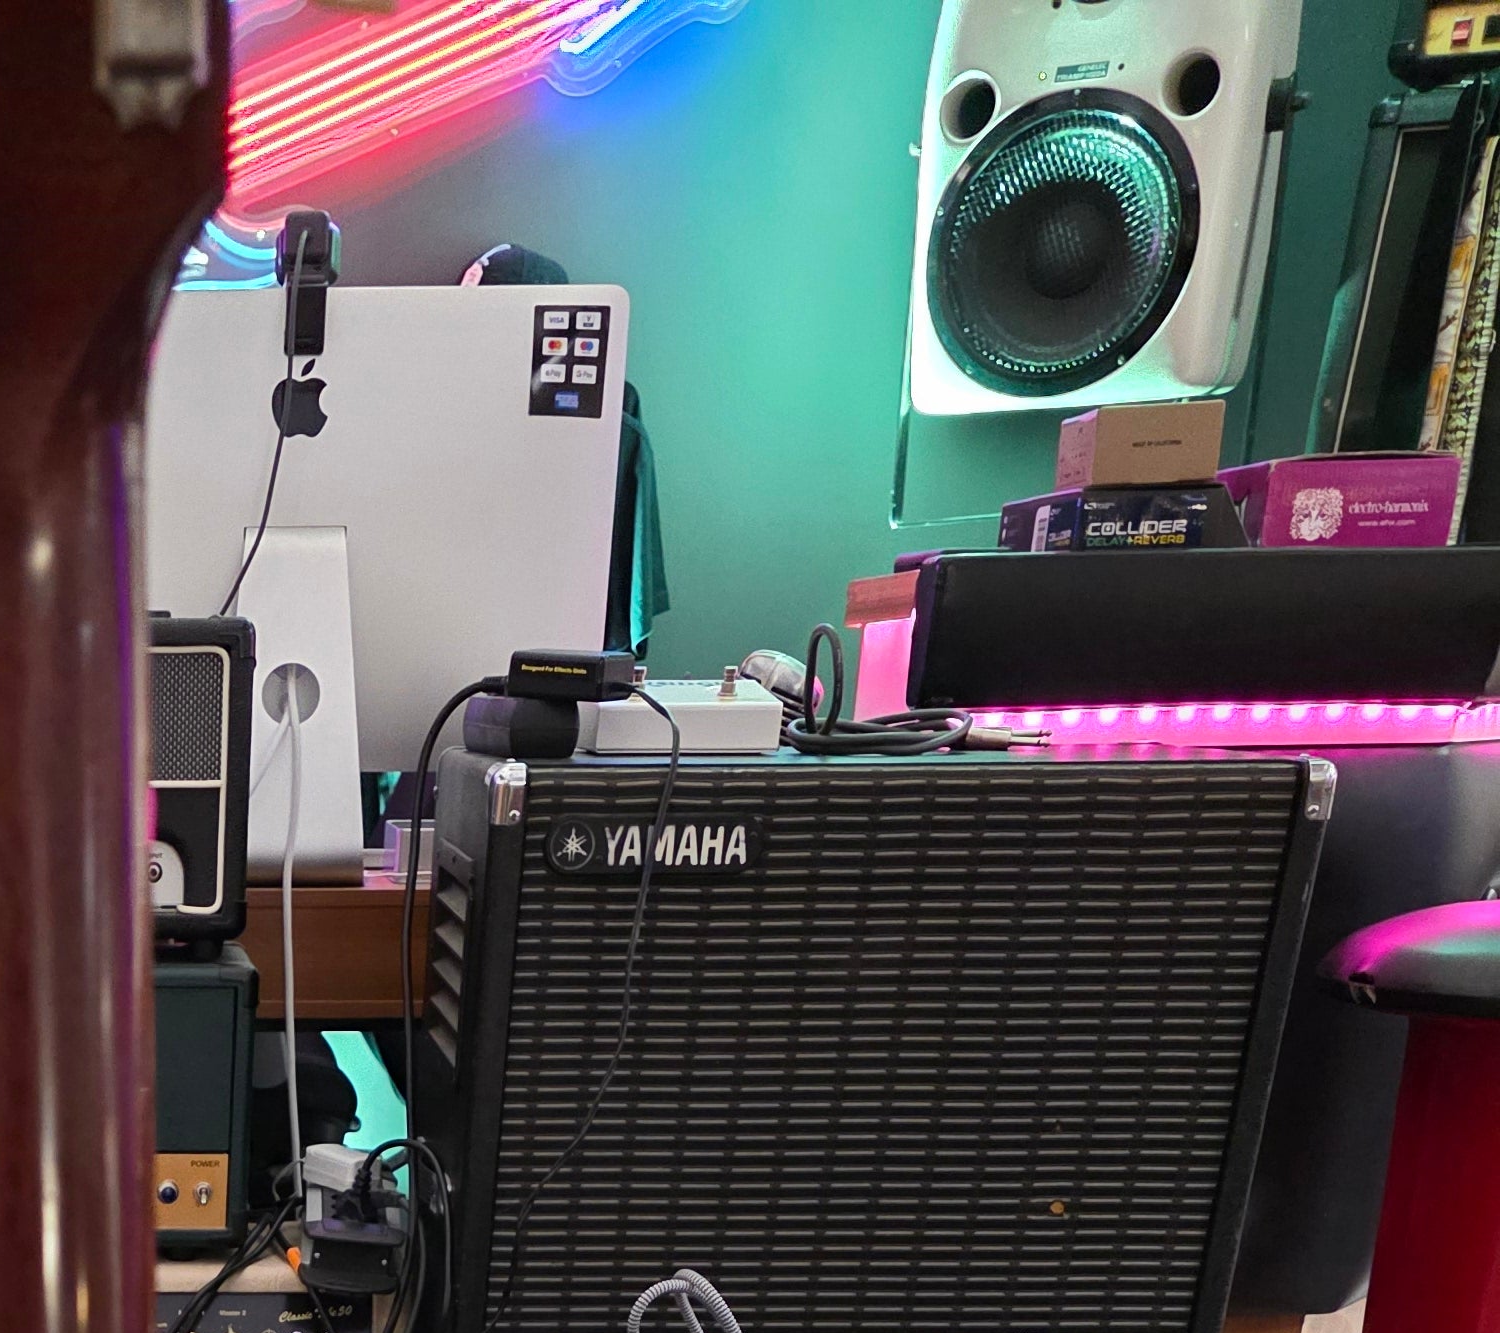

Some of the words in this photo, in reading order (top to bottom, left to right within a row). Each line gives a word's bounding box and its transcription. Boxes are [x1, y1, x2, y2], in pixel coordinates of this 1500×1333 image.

[1087, 519, 1188, 536] COLLIDER
[605, 825, 747, 866] YAMAHA
[278, 1310, 313, 1323] Classic
